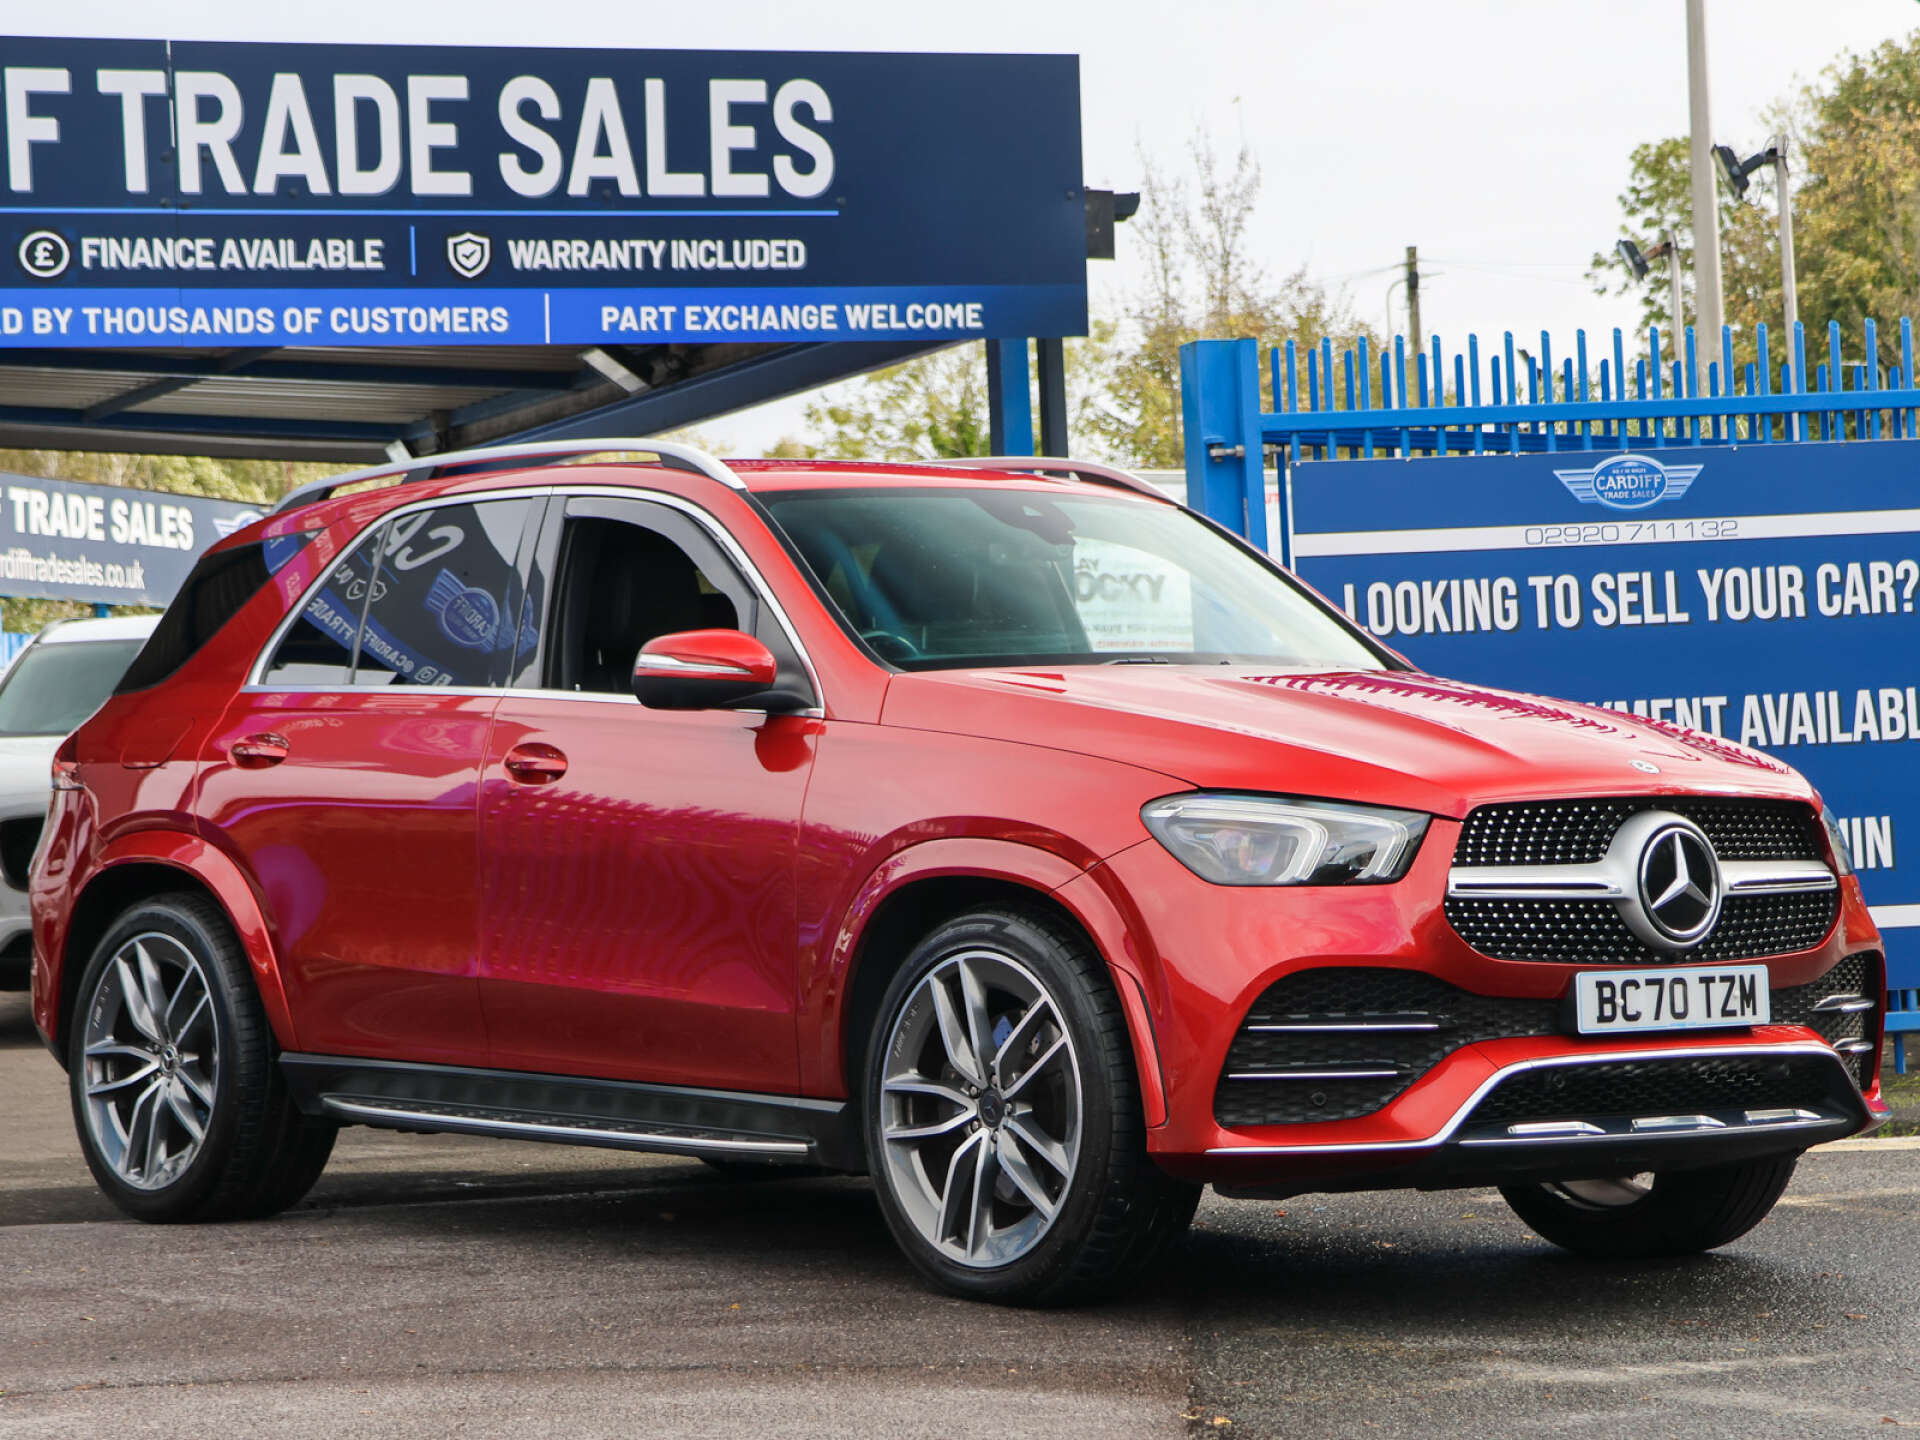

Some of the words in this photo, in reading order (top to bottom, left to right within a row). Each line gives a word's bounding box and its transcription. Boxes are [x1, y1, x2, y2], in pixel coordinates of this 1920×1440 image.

[96, 69, 473, 195] TRADE
[498, 75, 834, 198] SALES
[81, 237, 217, 269] FINANCE
[219, 239, 385, 269] AVAILABLE
[508, 240, 665, 270] WARRANTY
[671, 240, 806, 269] INCLUDED
[0, 307, 24, 335] D
[32, 307, 71, 335] BY
[82, 307, 274, 334] THOUSANDS
[283, 307, 321, 333] OF
[330, 306, 509, 333] CUSTOMERS
[601, 305, 676, 332] PART
[685, 304, 838, 331] EXCHANGE
[845, 303, 983, 329] WELCOME
[1596, 474, 1662, 490] CARDIFF
[8, 486, 105, 541] TRADE
[110, 498, 194, 551] SALES
[1344, 578, 1518, 636] LOOKING
[1528, 575, 1581, 629] TO
[1591, 571, 1689, 626] SELL
[1698, 566, 1807, 620] YOUR
[1817, 559, 1920, 616] CAR?
[1595, 977, 1689, 1023] BC70
[1699, 974, 1757, 1018] TZM
